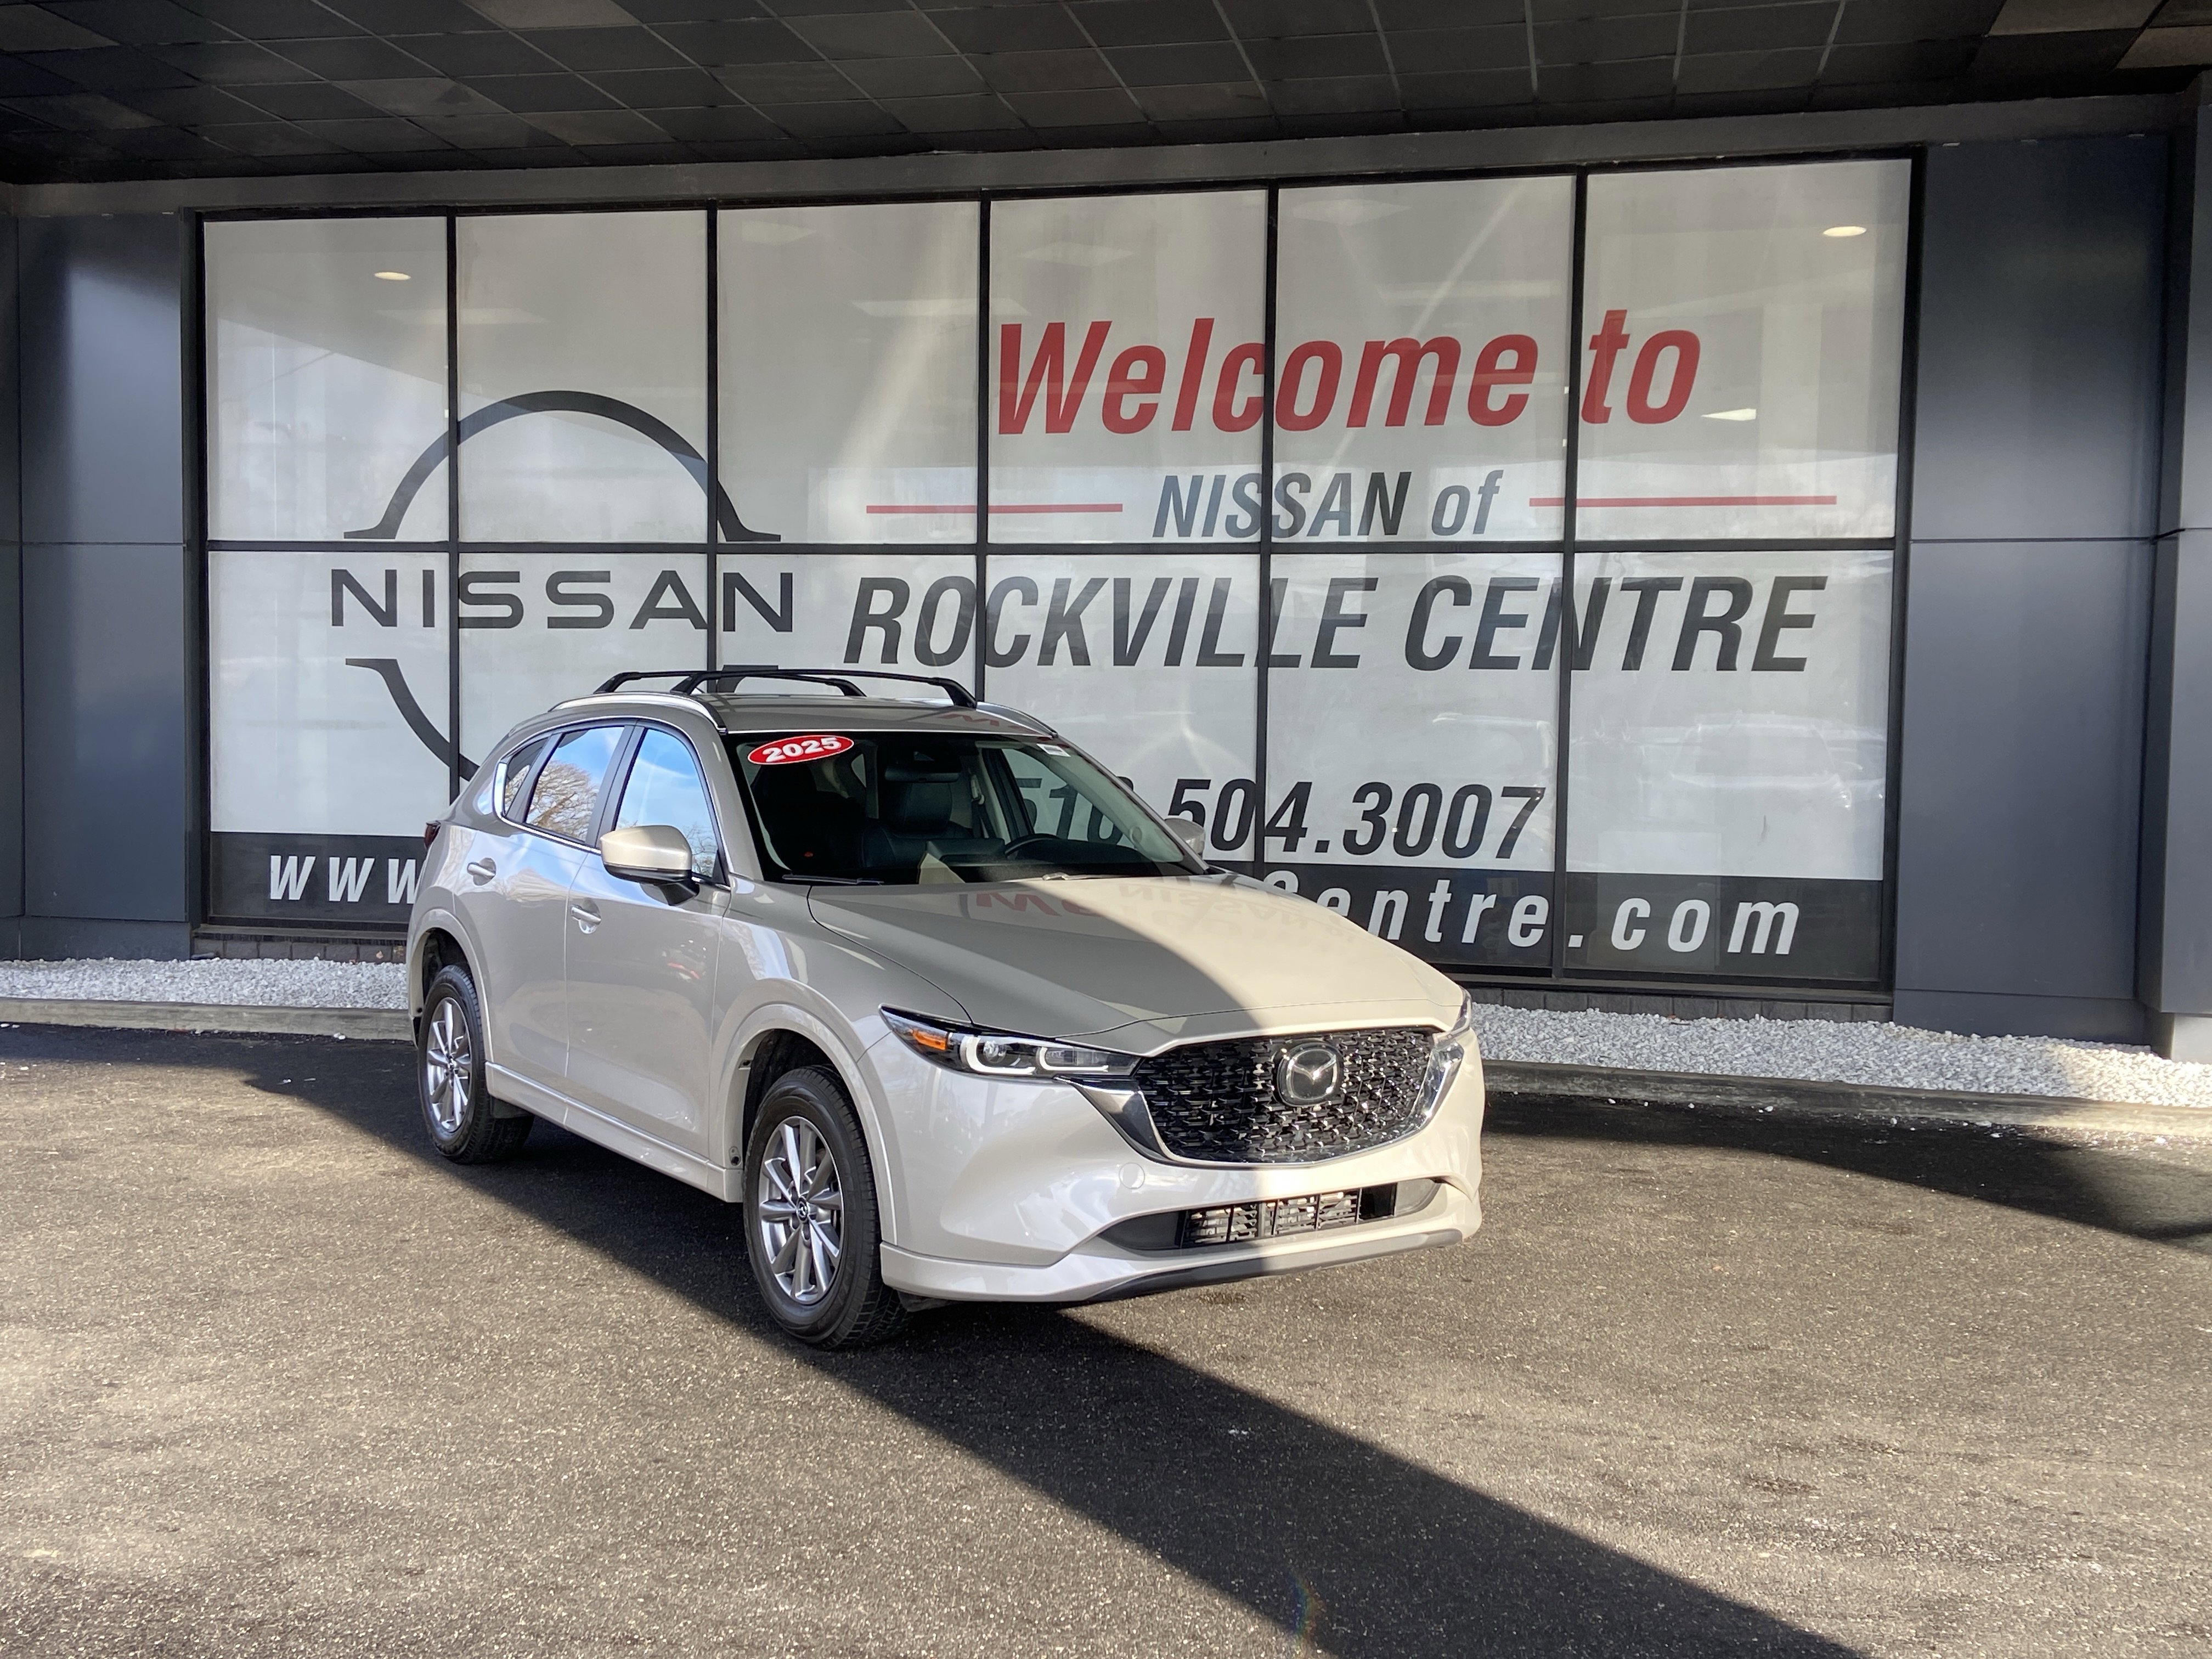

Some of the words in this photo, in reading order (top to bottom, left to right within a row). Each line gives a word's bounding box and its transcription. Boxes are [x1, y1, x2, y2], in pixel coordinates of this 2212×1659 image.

[998, 317, 1538, 435] Welcome
[1581, 309, 1701, 424] to
[1152, 471, 1412, 538] NISSAN
[1431, 470, 1504, 536] of
[331, 568, 793, 632] NISSAN
[843, 576, 1379, 668] ROCKVILLE
[1405, 575, 1829, 672] CENTRE
[762, 737, 842, 763] 2025
